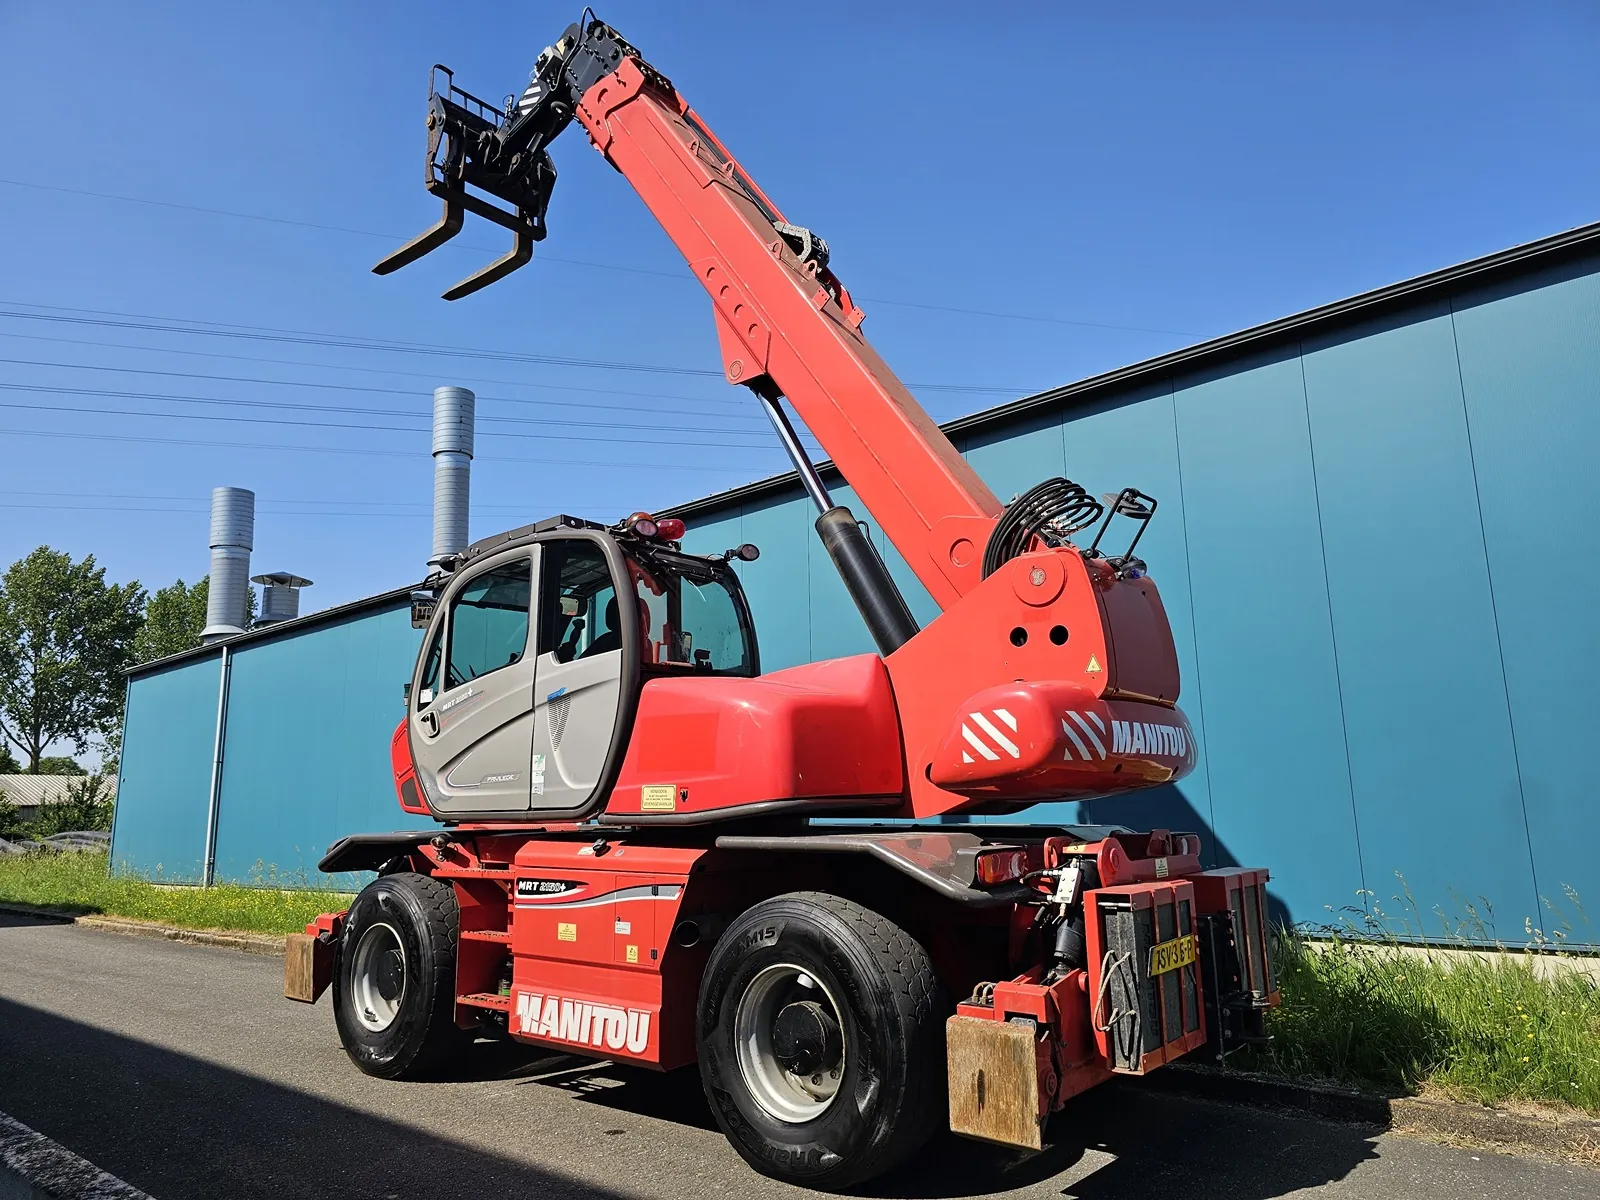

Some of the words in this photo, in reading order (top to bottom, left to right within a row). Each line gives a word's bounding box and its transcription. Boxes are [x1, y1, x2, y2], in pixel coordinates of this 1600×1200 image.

[1111, 720, 1186, 757] MANITOU
[518, 880, 539, 891] MRT
[737, 926, 777, 951] AM15
[517, 990, 653, 1053] MANITOU
